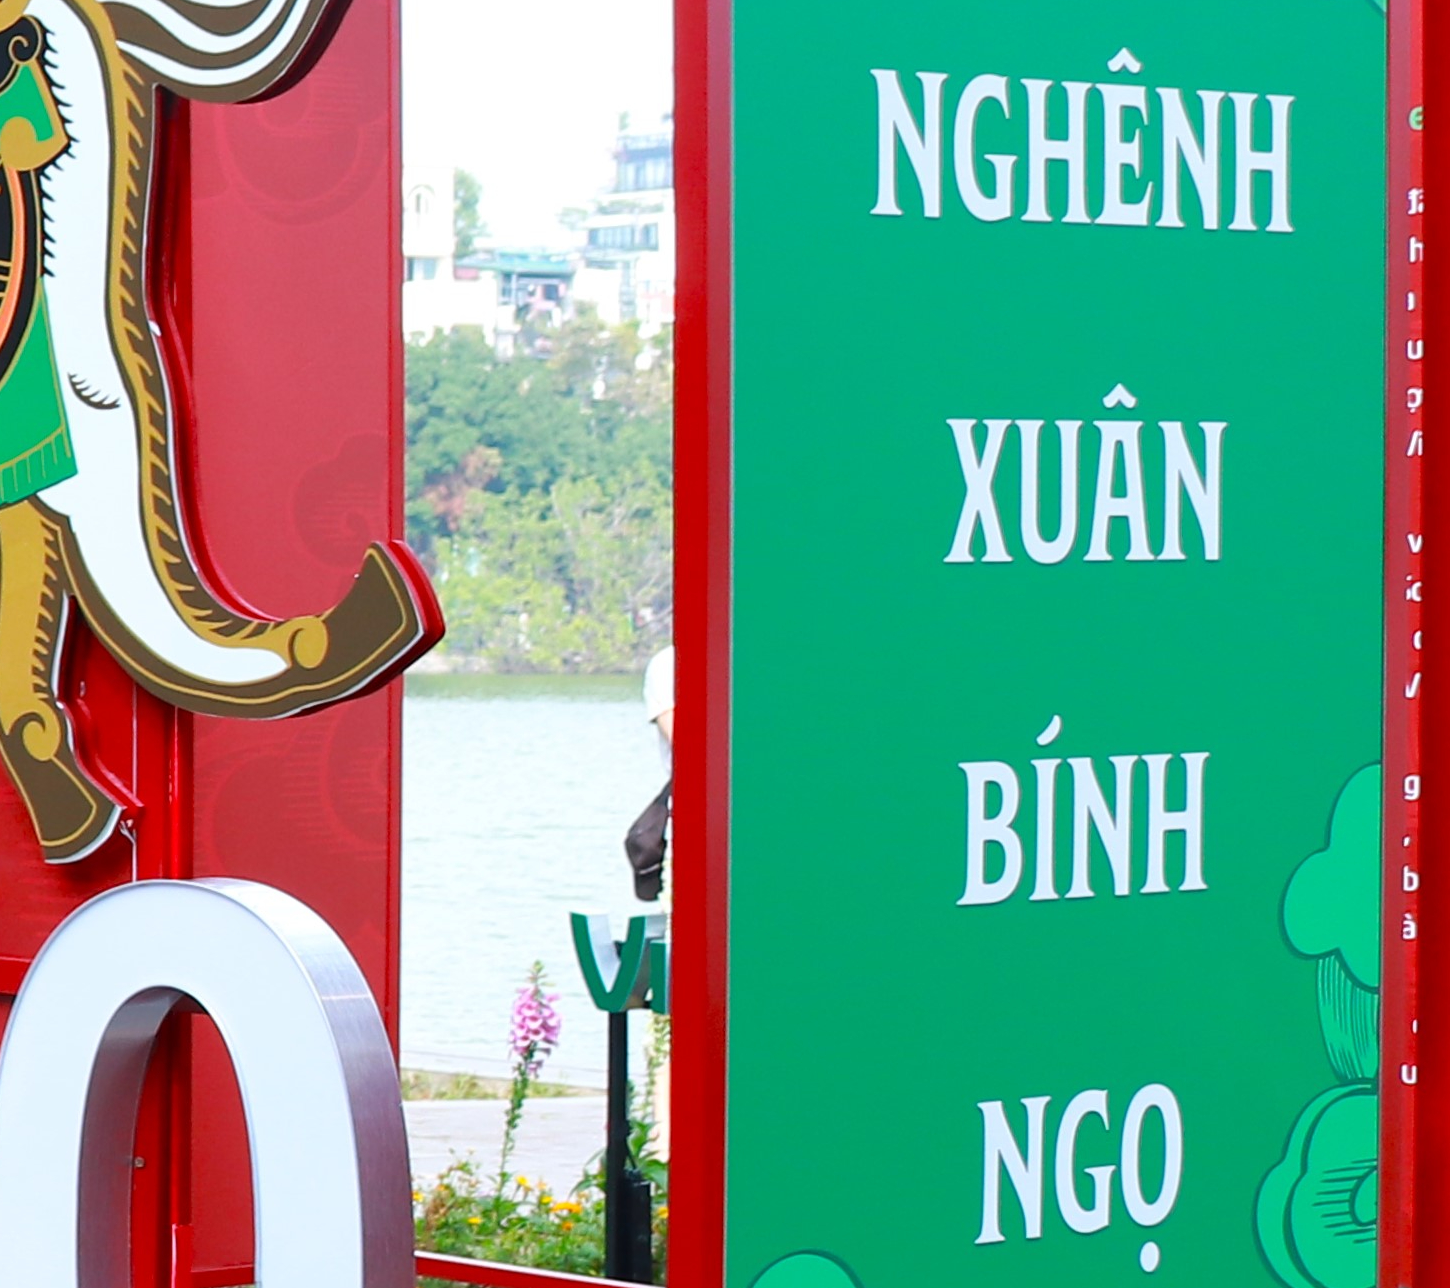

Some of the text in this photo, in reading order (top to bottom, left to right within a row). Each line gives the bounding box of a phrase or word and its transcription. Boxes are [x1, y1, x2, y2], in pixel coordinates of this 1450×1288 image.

[869, 48, 1297, 233] NGHÊNH
[943, 383, 1229, 565] XUÂN
[956, 715, 1210, 908] BÍNH
[975, 1084, 1183, 1273] NGỌ
